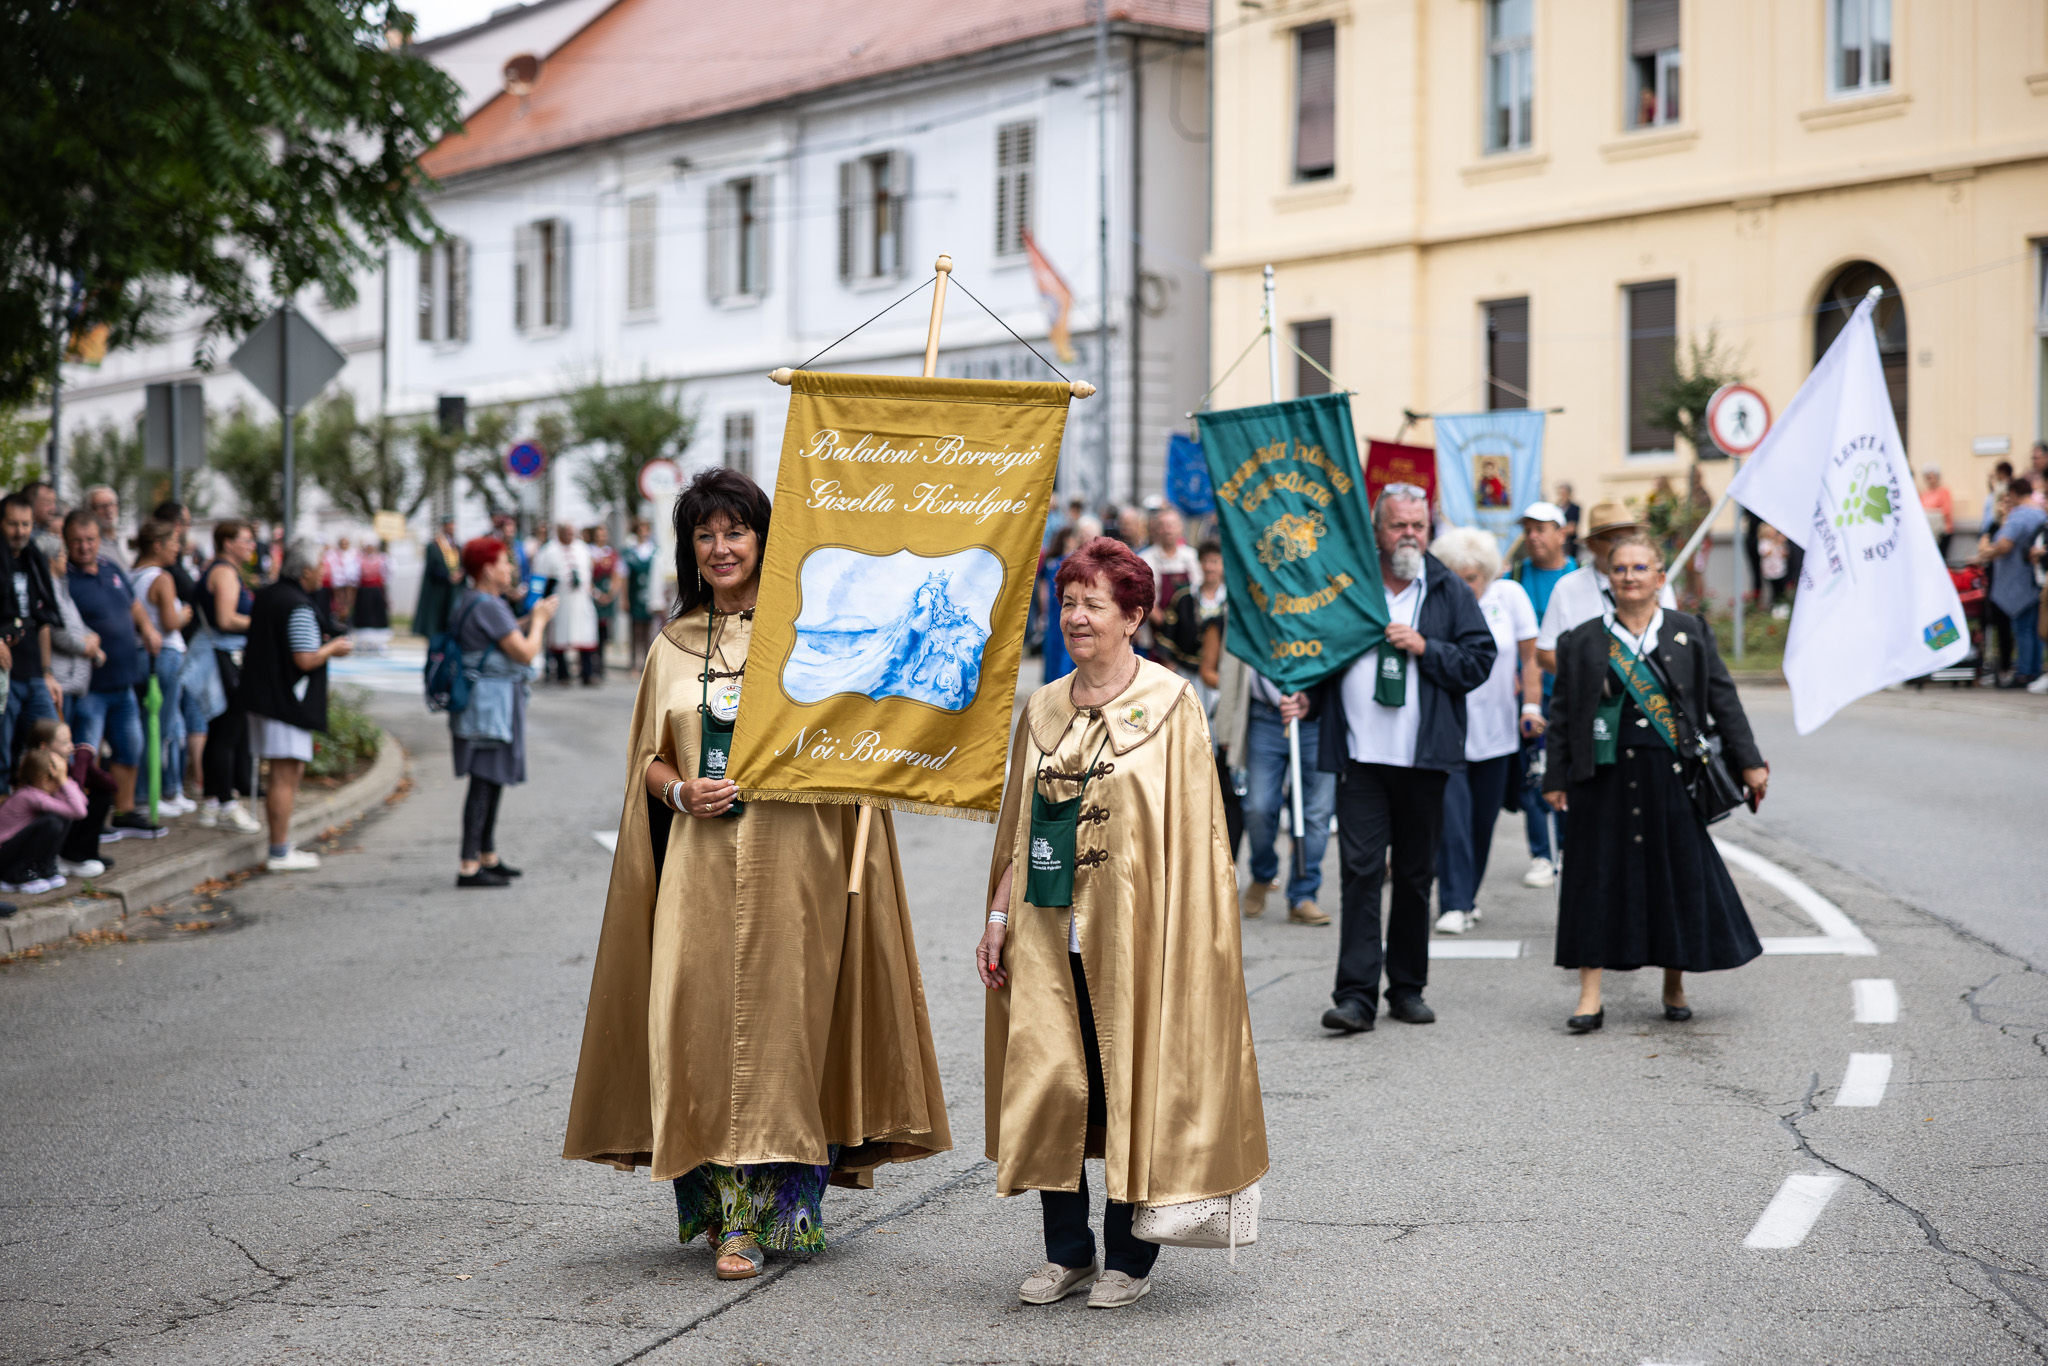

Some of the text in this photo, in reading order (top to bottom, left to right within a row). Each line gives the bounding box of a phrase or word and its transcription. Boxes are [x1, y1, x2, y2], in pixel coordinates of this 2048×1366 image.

[798, 428, 1044, 477] Balatoni Borrégió
[805, 478, 1031, 526] Gizella Királyné
[774, 726, 958, 771] Női Borrend
